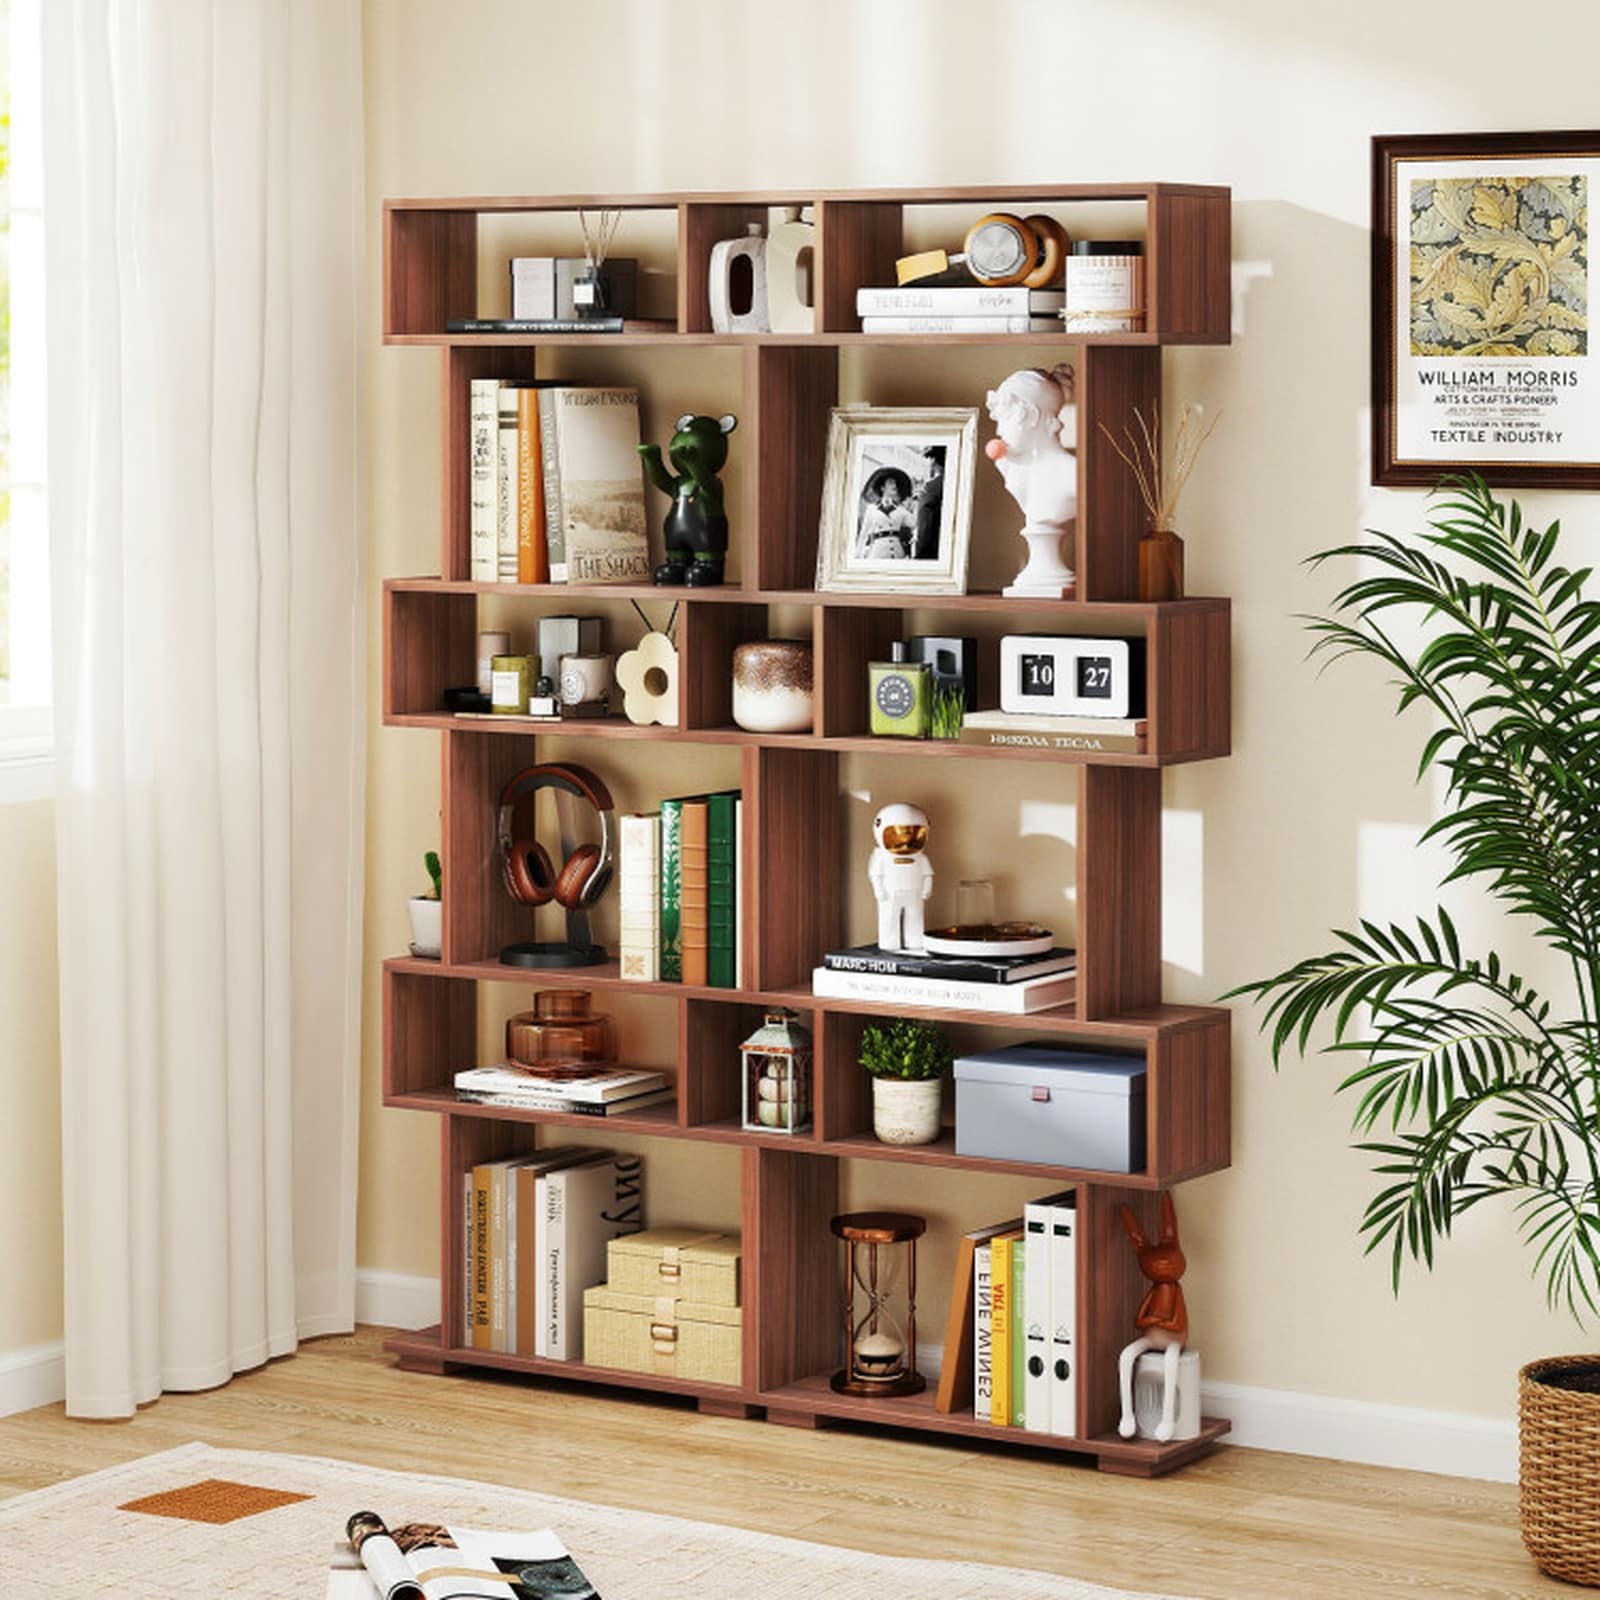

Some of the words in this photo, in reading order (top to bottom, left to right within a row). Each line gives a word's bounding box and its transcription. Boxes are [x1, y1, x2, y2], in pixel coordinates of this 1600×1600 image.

[1418, 370, 1495, 385] WILLIAM
[1507, 370, 1579, 386] MORRIS
[1433, 394, 1460, 404] ARTS
[1471, 394, 1512, 404] CRAFTS
[1514, 394, 1558, 405] PIONEER
[1430, 430, 1486, 443] TEXTILE
[1494, 430, 1563, 443] INDUSTRY
[574, 556, 600, 578] THE
[1030, 665, 1053, 685] 10
[1085, 667, 1110, 688] 27
[1054, 736, 1102, 749] ТЕСЛА
[831, 957, 867, 971] MARC
[868, 961, 897, 973] HOM
